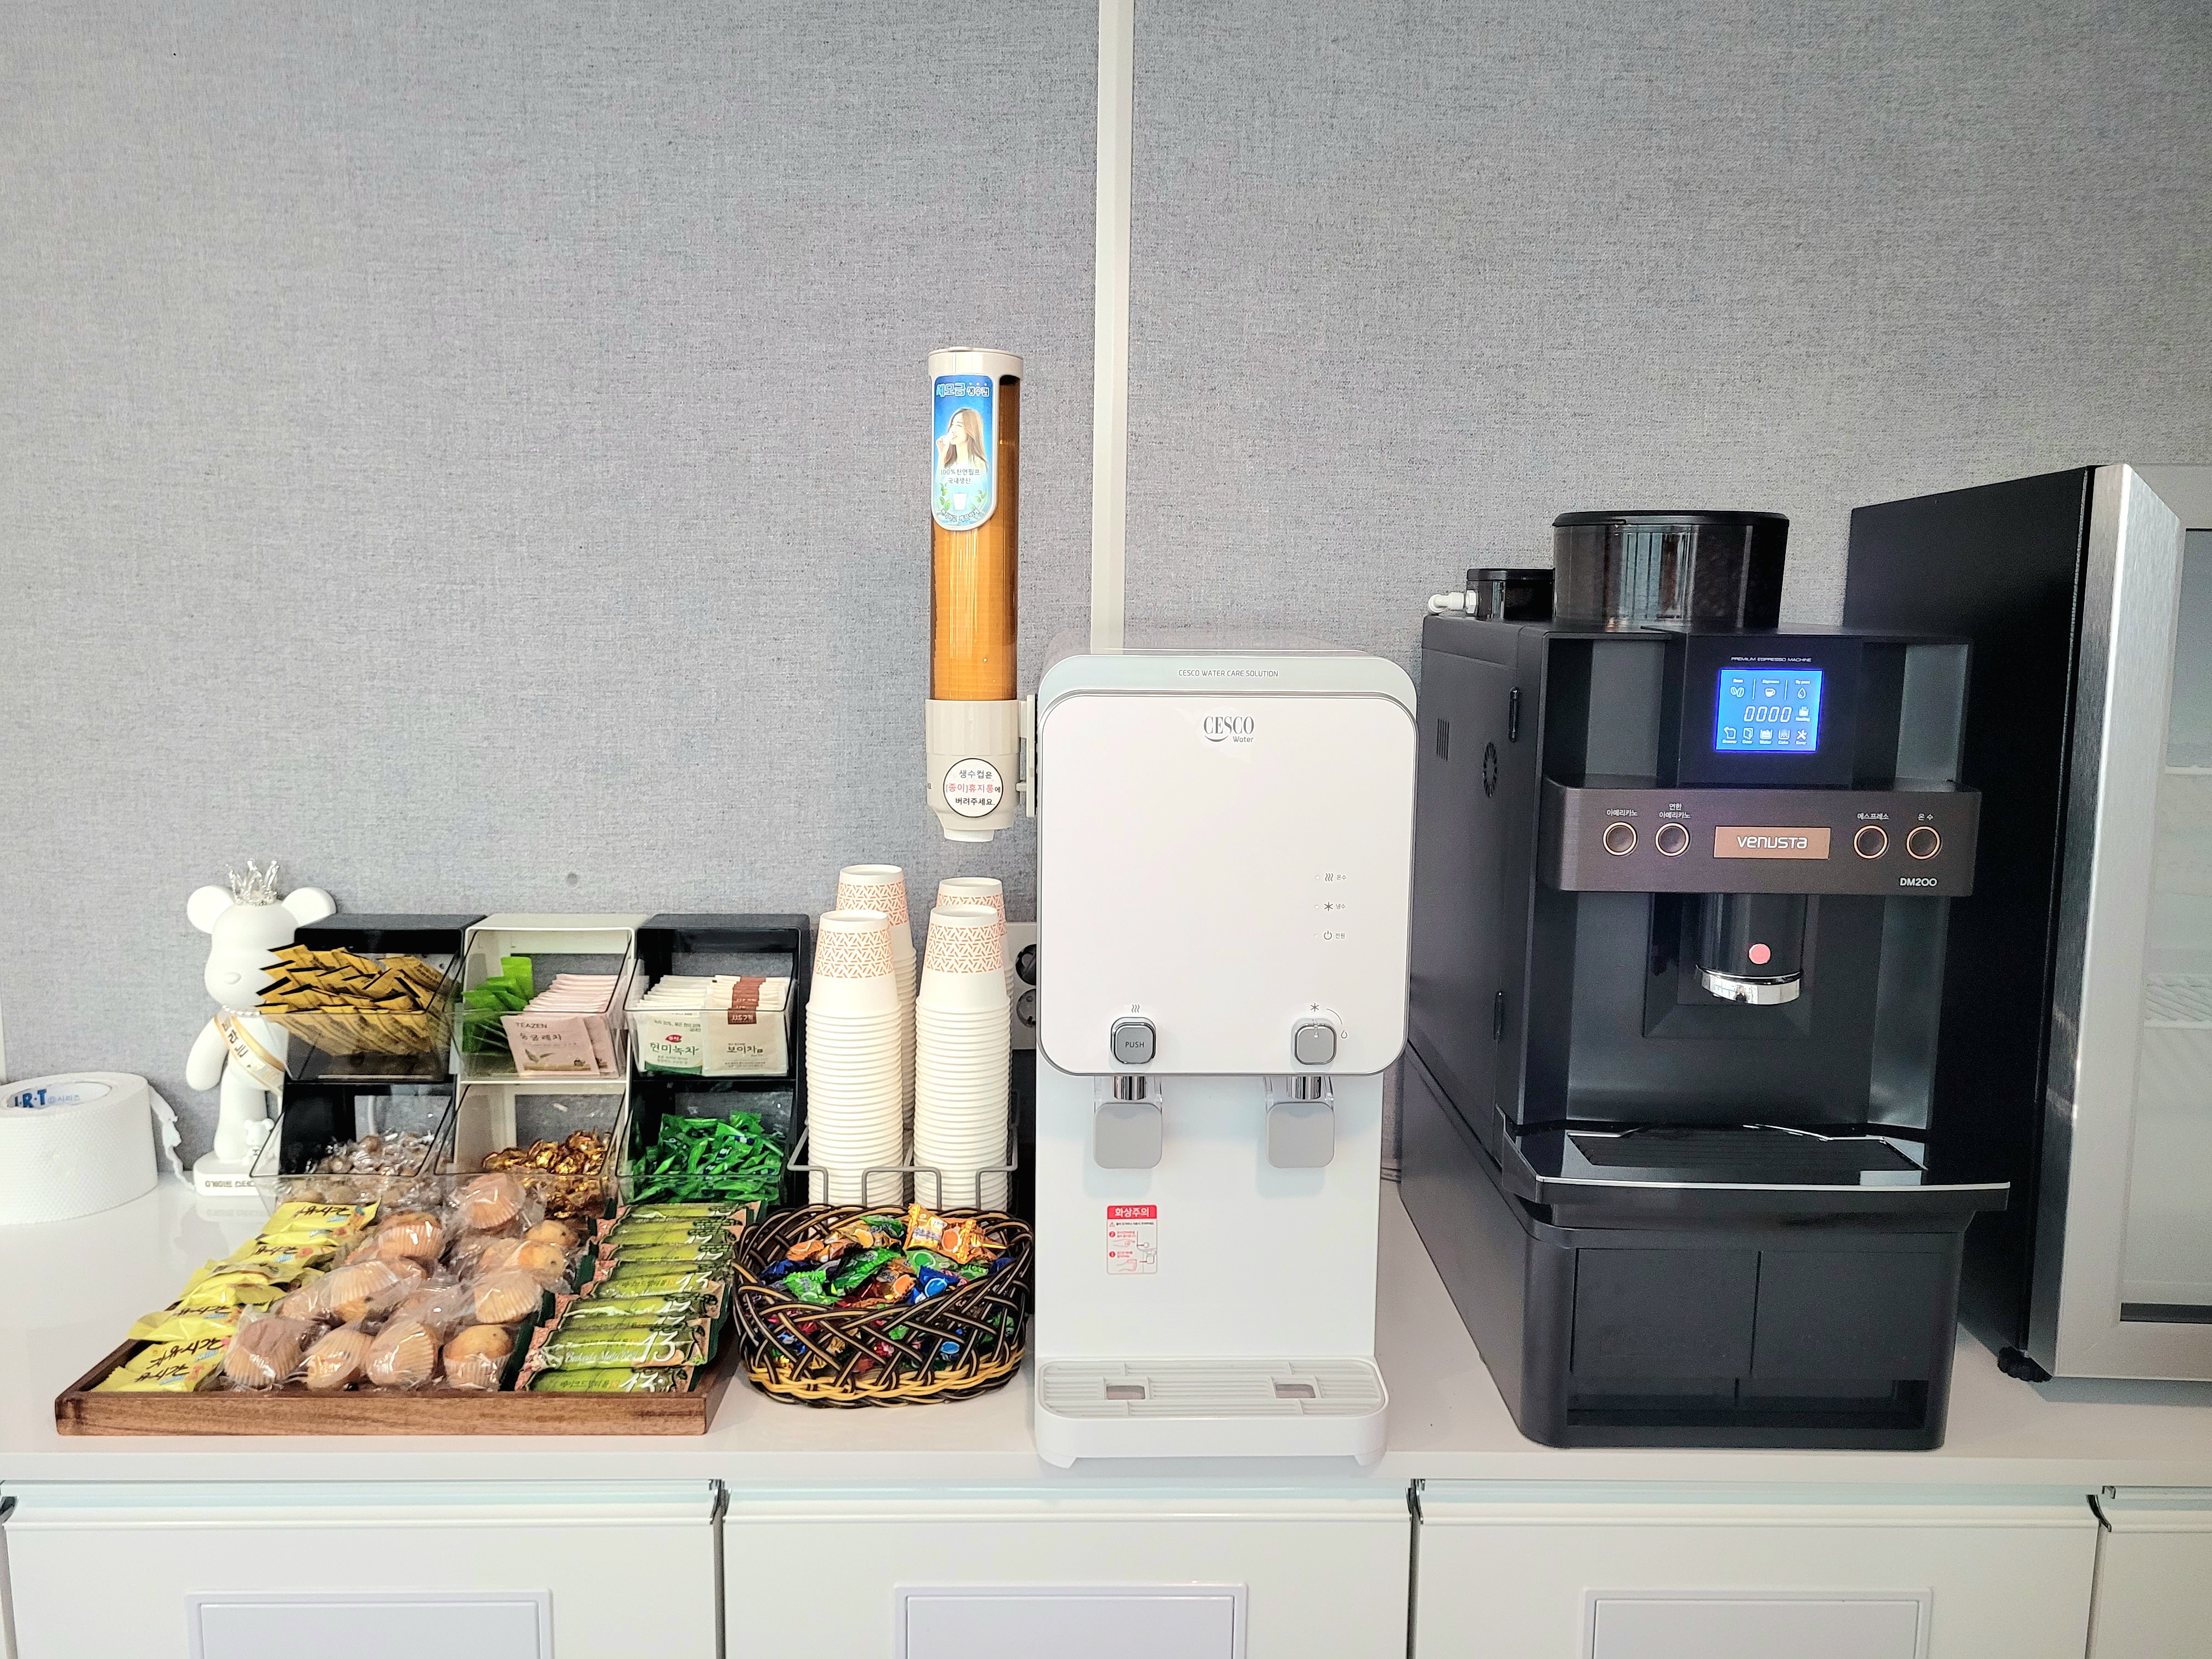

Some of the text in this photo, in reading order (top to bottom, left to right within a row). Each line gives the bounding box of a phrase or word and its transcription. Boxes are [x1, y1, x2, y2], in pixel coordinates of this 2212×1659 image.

[936, 382, 966, 397] 세모금
[1743, 706, 1792, 722] 0000
[1204, 716, 1255, 735] CESCO
[959, 770, 992, 779] 생수컵은
[955, 797, 995, 806] 버려주세요.
[650, 1042, 700, 1056] 현미녹차
[726, 1045, 757, 1054] 보이차
[1114, 1207, 1149, 1218] 화상주의
[637, 1330, 678, 1363] 13
